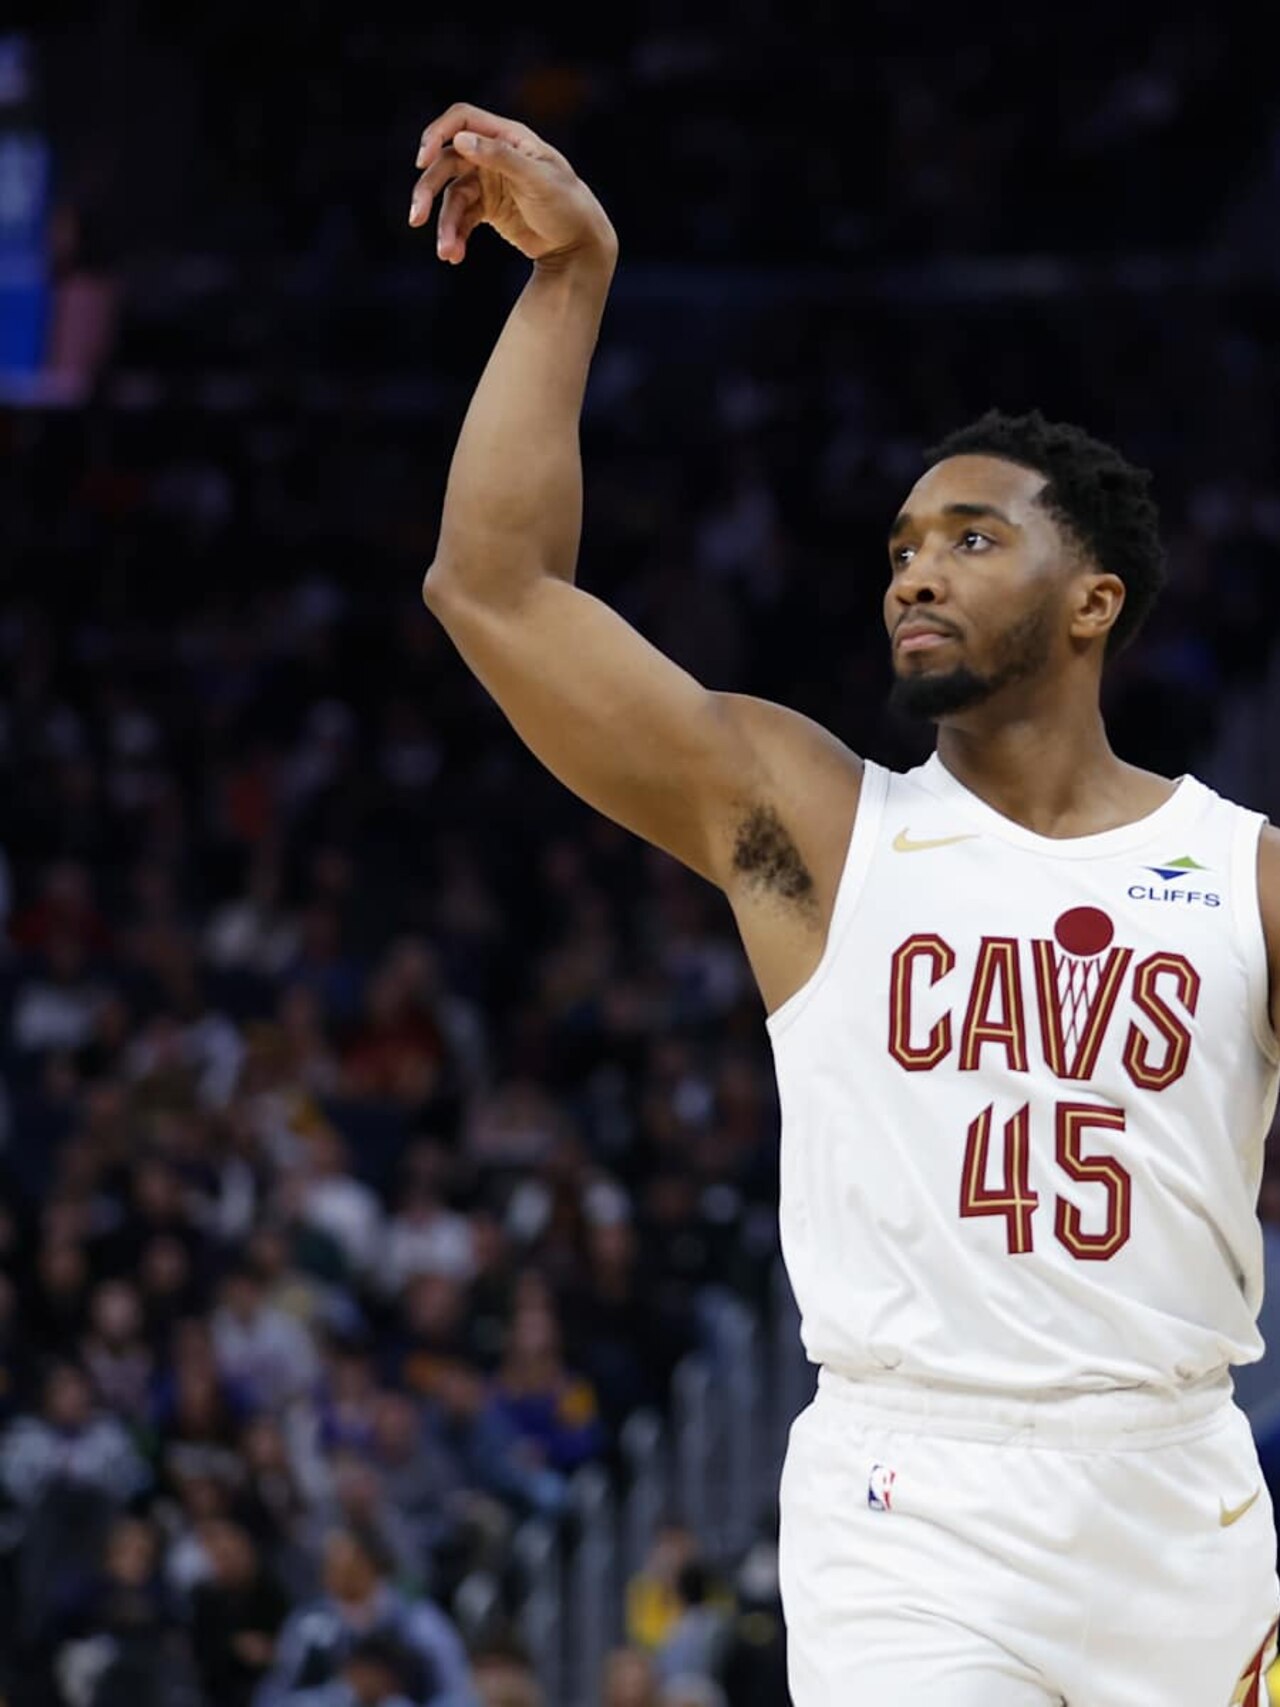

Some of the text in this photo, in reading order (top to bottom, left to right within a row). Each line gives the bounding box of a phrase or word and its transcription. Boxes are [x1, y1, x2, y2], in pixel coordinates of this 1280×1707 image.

[1127, 885, 1221, 908] CLIFFS
[888, 932, 1201, 1092] CAVS
[960, 1102, 1131, 1261] 45
